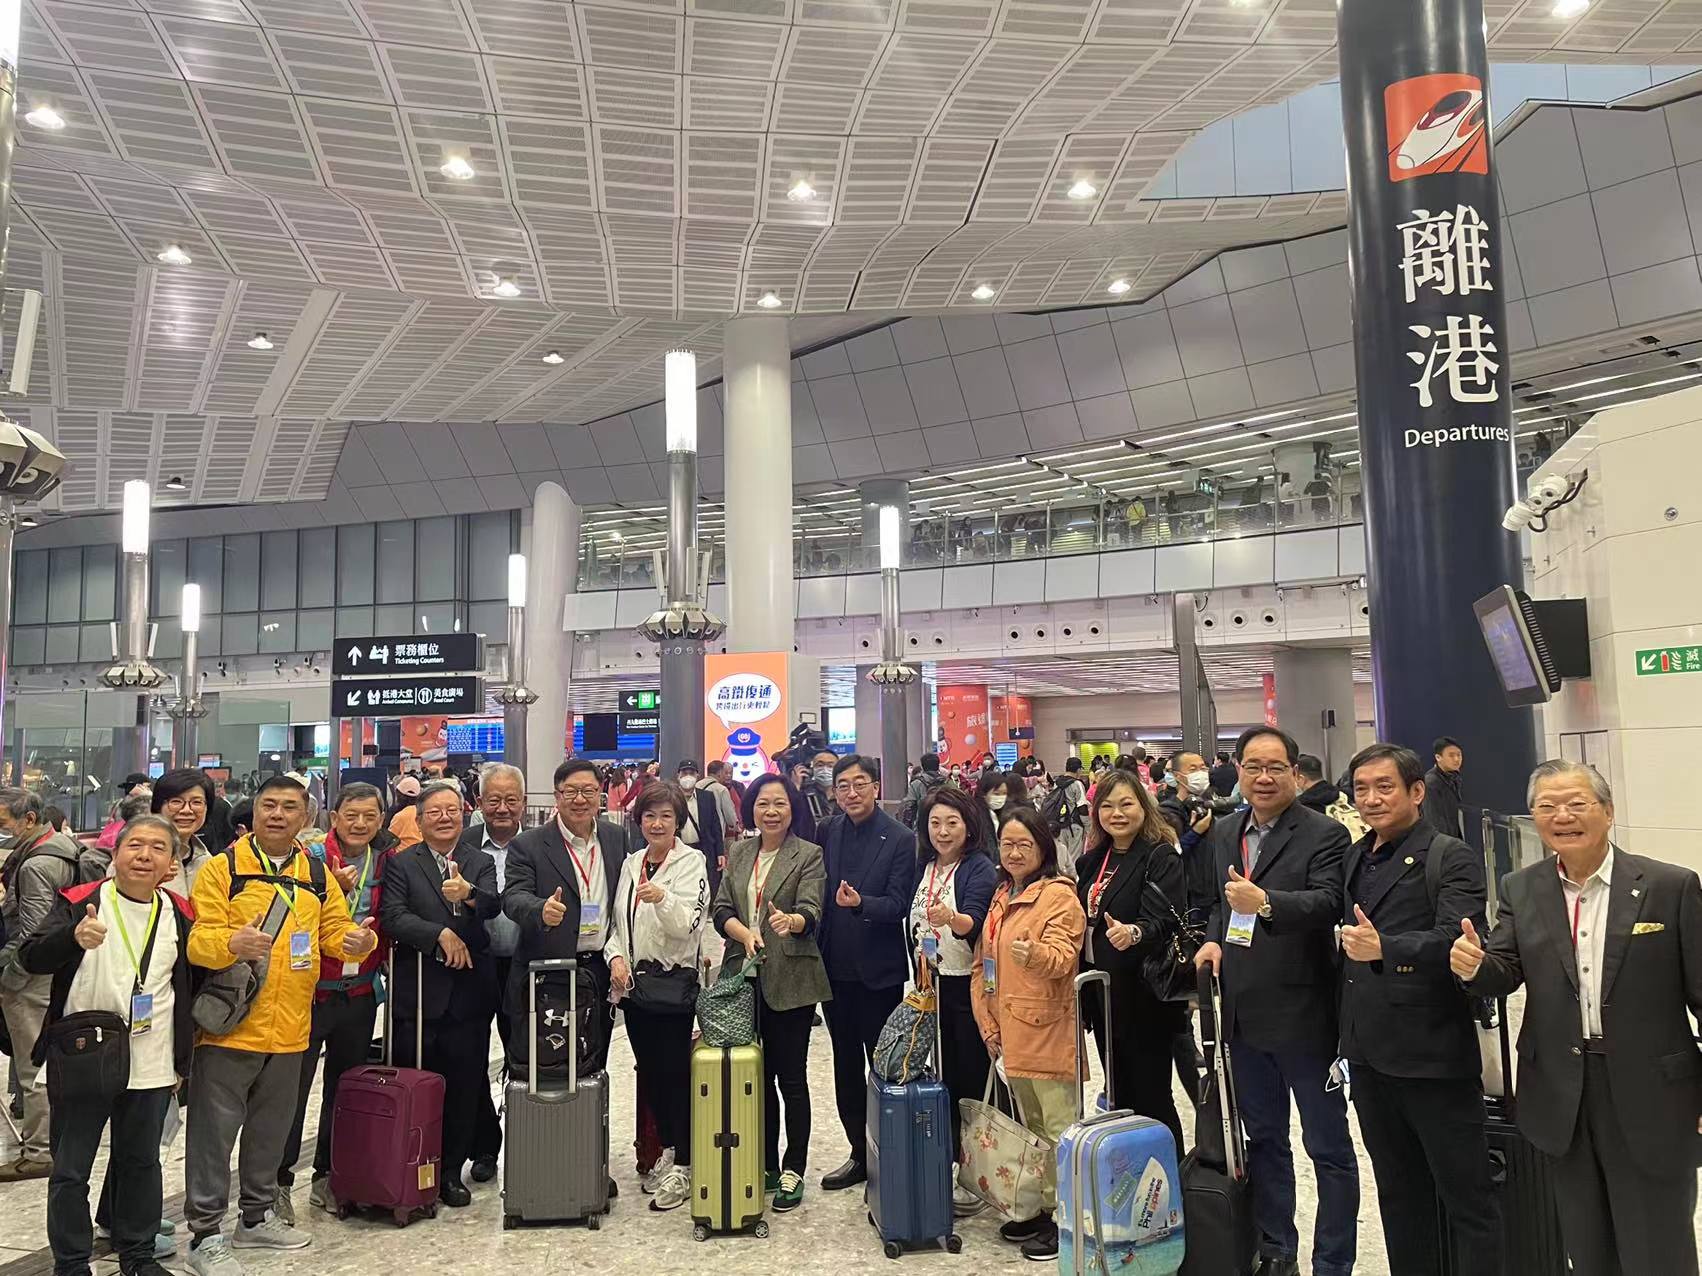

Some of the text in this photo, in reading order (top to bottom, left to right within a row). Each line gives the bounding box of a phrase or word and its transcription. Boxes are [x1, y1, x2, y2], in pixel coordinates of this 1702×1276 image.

[1396, 204, 1500, 408] 離港
[1404, 423, 1510, 447] Departures
[395, 643, 439, 656] 票務櫃位
[395, 657, 419, 665] Ticketing
[1686, 662, 1701, 670] Fire
